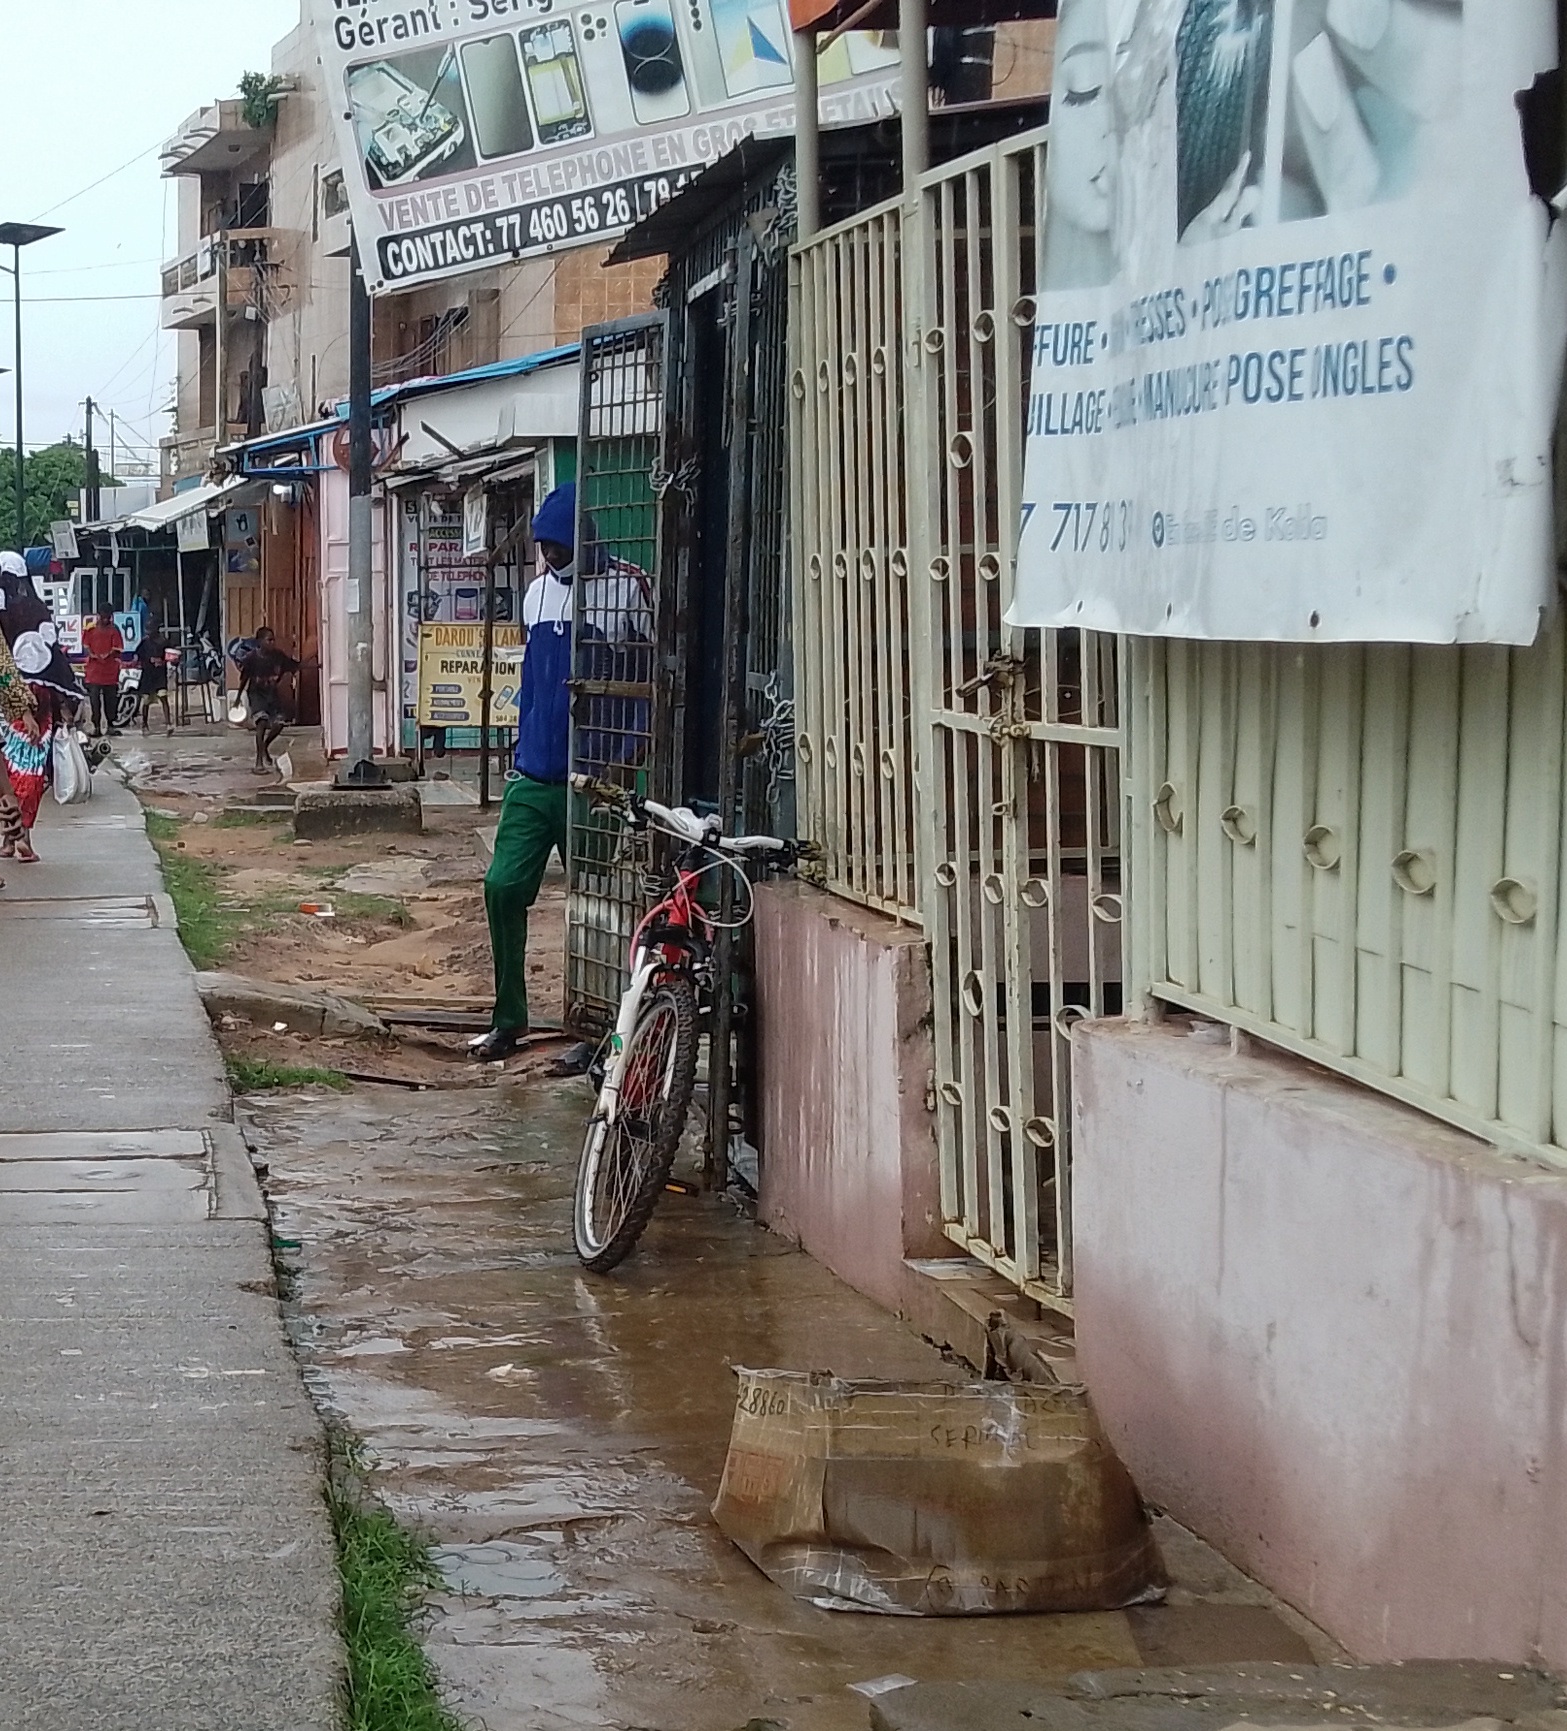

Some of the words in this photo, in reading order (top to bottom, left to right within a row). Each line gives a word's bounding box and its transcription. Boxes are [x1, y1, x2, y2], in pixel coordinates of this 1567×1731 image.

[334, 5, 441, 50] Gérant
[378, 187, 461, 232] VENTE
[464, 175, 499, 214] DE
[501, 139, 648, 198] TELEPHONE
[651, 130, 683, 167] EN
[692, 117, 757, 159] GROS
[386, 222, 493, 276] CONTACT:
[495, 213, 522, 250] 77
[529, 201, 569, 243] 460
[571, 195, 599, 233] 56
[601, 187, 631, 227] 26
[1225, 348, 1308, 406] POSE
[440, 660, 516, 675] REPARION
